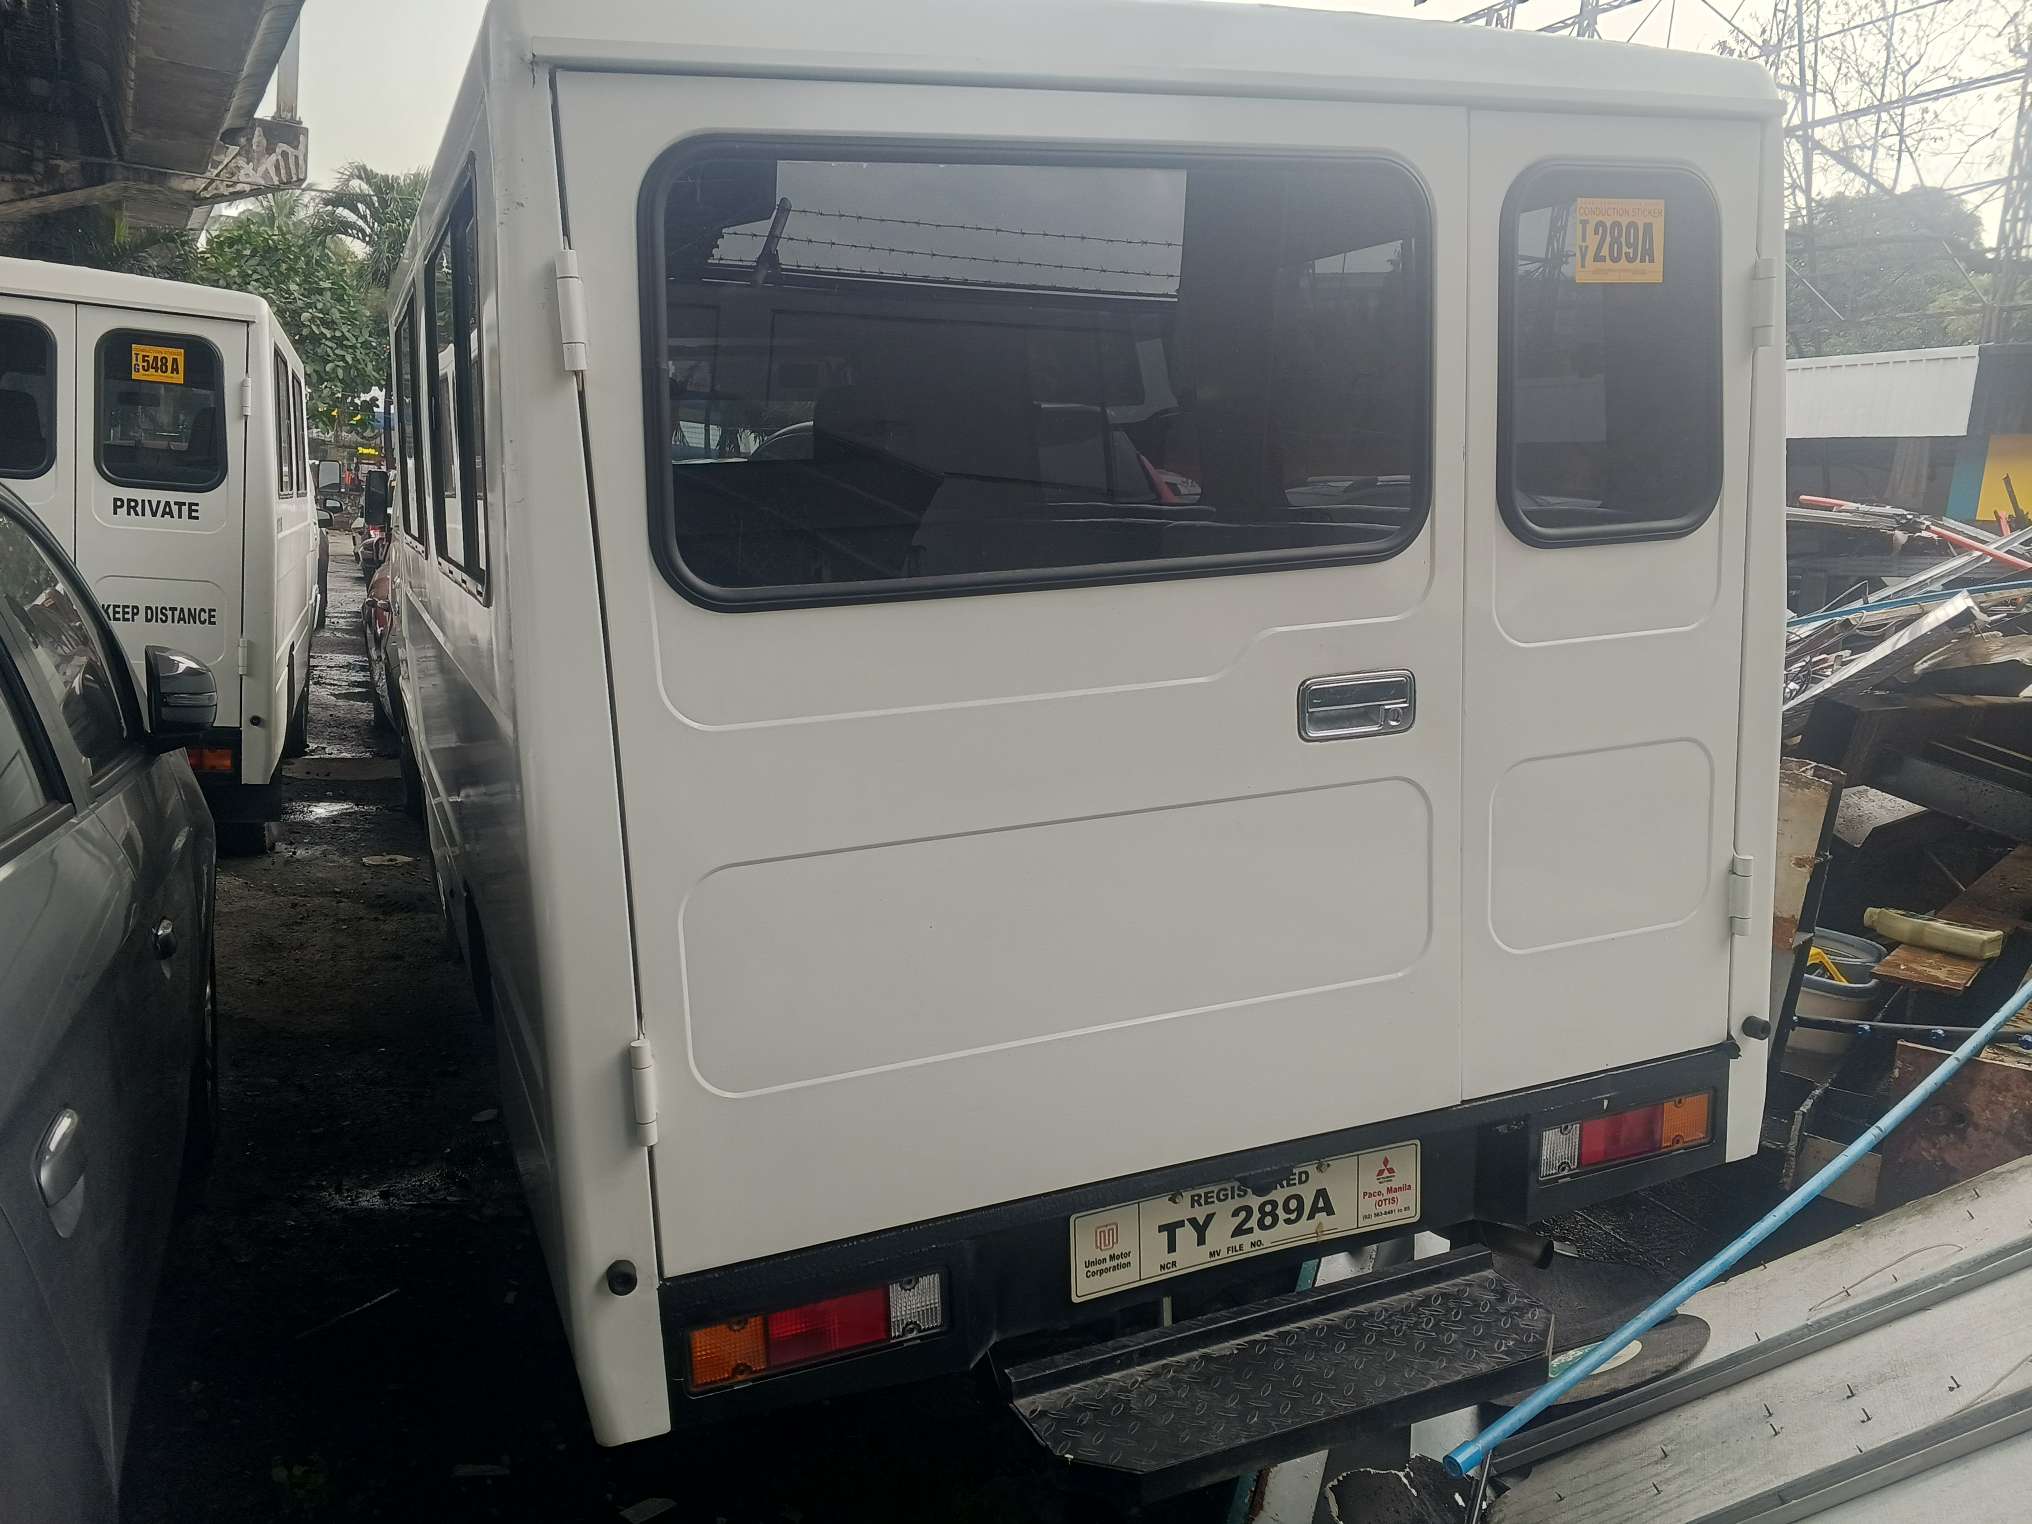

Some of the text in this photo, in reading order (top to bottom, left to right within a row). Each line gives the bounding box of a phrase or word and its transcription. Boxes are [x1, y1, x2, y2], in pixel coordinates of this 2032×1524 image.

[1592, 220, 1656, 264] 289A
[141, 354, 180, 375] 548A
[112, 497, 200, 521] PRIVATE
[101, 603, 217, 626] KEEP DISTANCE
[1362, 1183, 1412, 1200] Paco, Manila
[1374, 1195, 1399, 1210] (OTIS)
[1158, 1187, 1337, 1255] TY 289A
[1084, 1251, 1132, 1269] Union Motor
[1208, 1239, 1265, 1260] MV FILE NO.
[1085, 1261, 1132, 1279] Corporation
[1159, 1260, 1178, 1272] NCR
